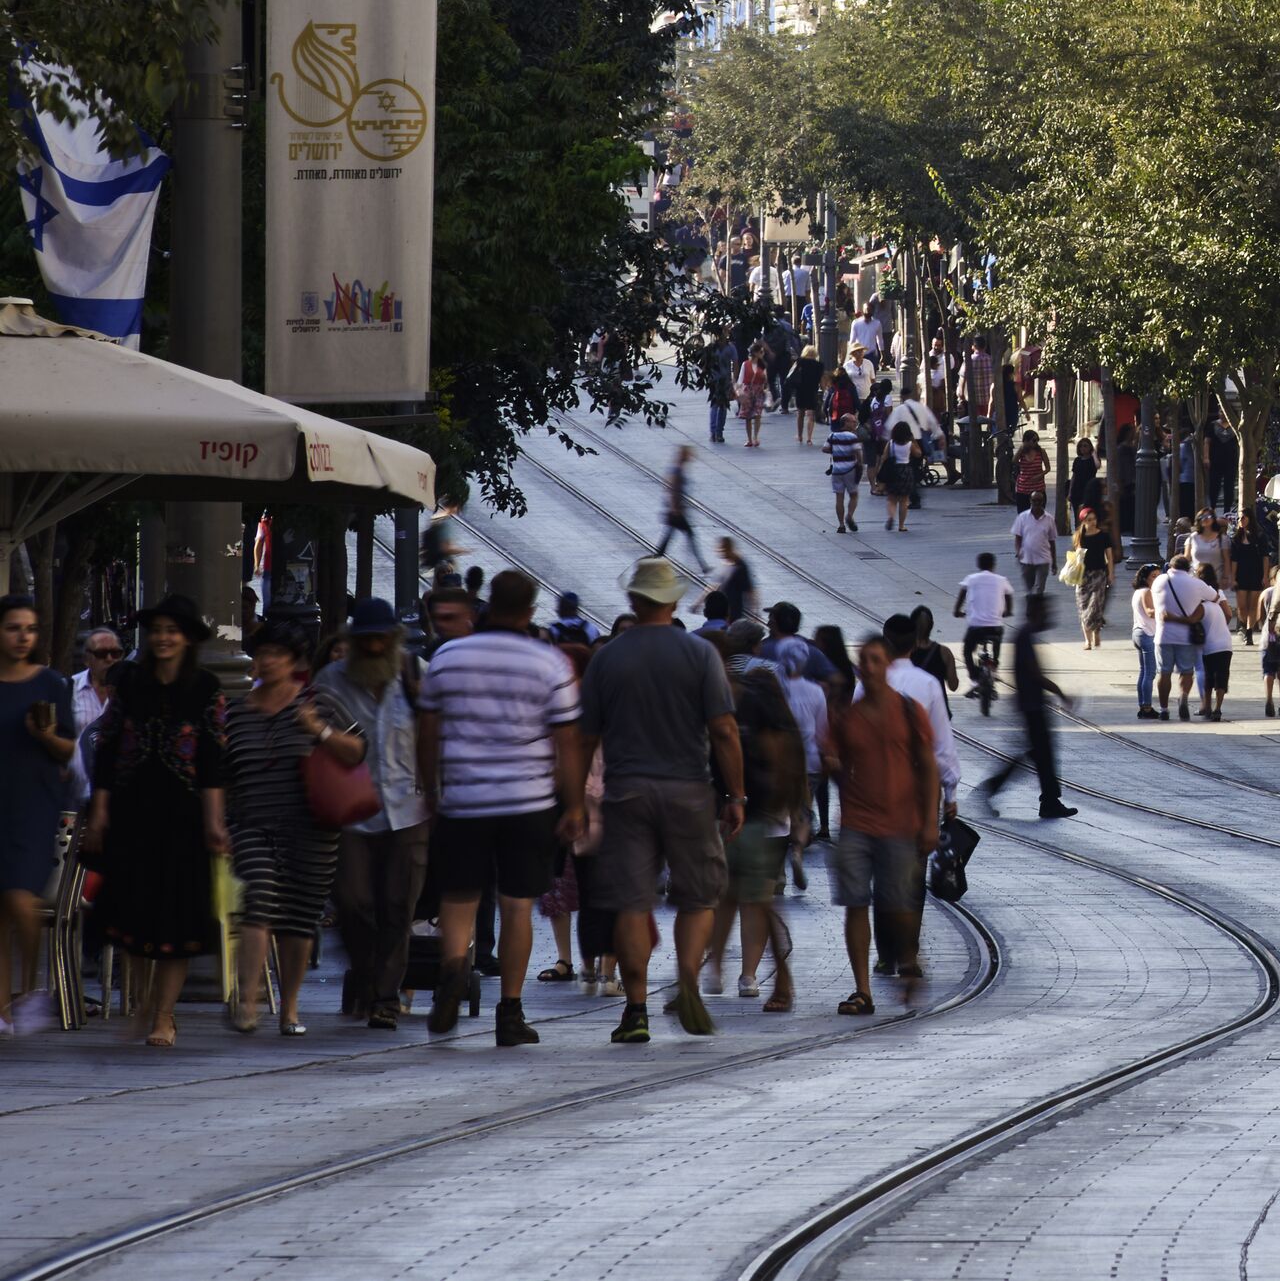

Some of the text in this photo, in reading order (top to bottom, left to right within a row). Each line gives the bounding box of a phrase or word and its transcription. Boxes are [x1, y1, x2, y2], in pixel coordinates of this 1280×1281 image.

[288, 141, 342, 160] ירושלים
[369, 166, 402, 179] ירושלים
[199, 441, 259, 469] קופיז
